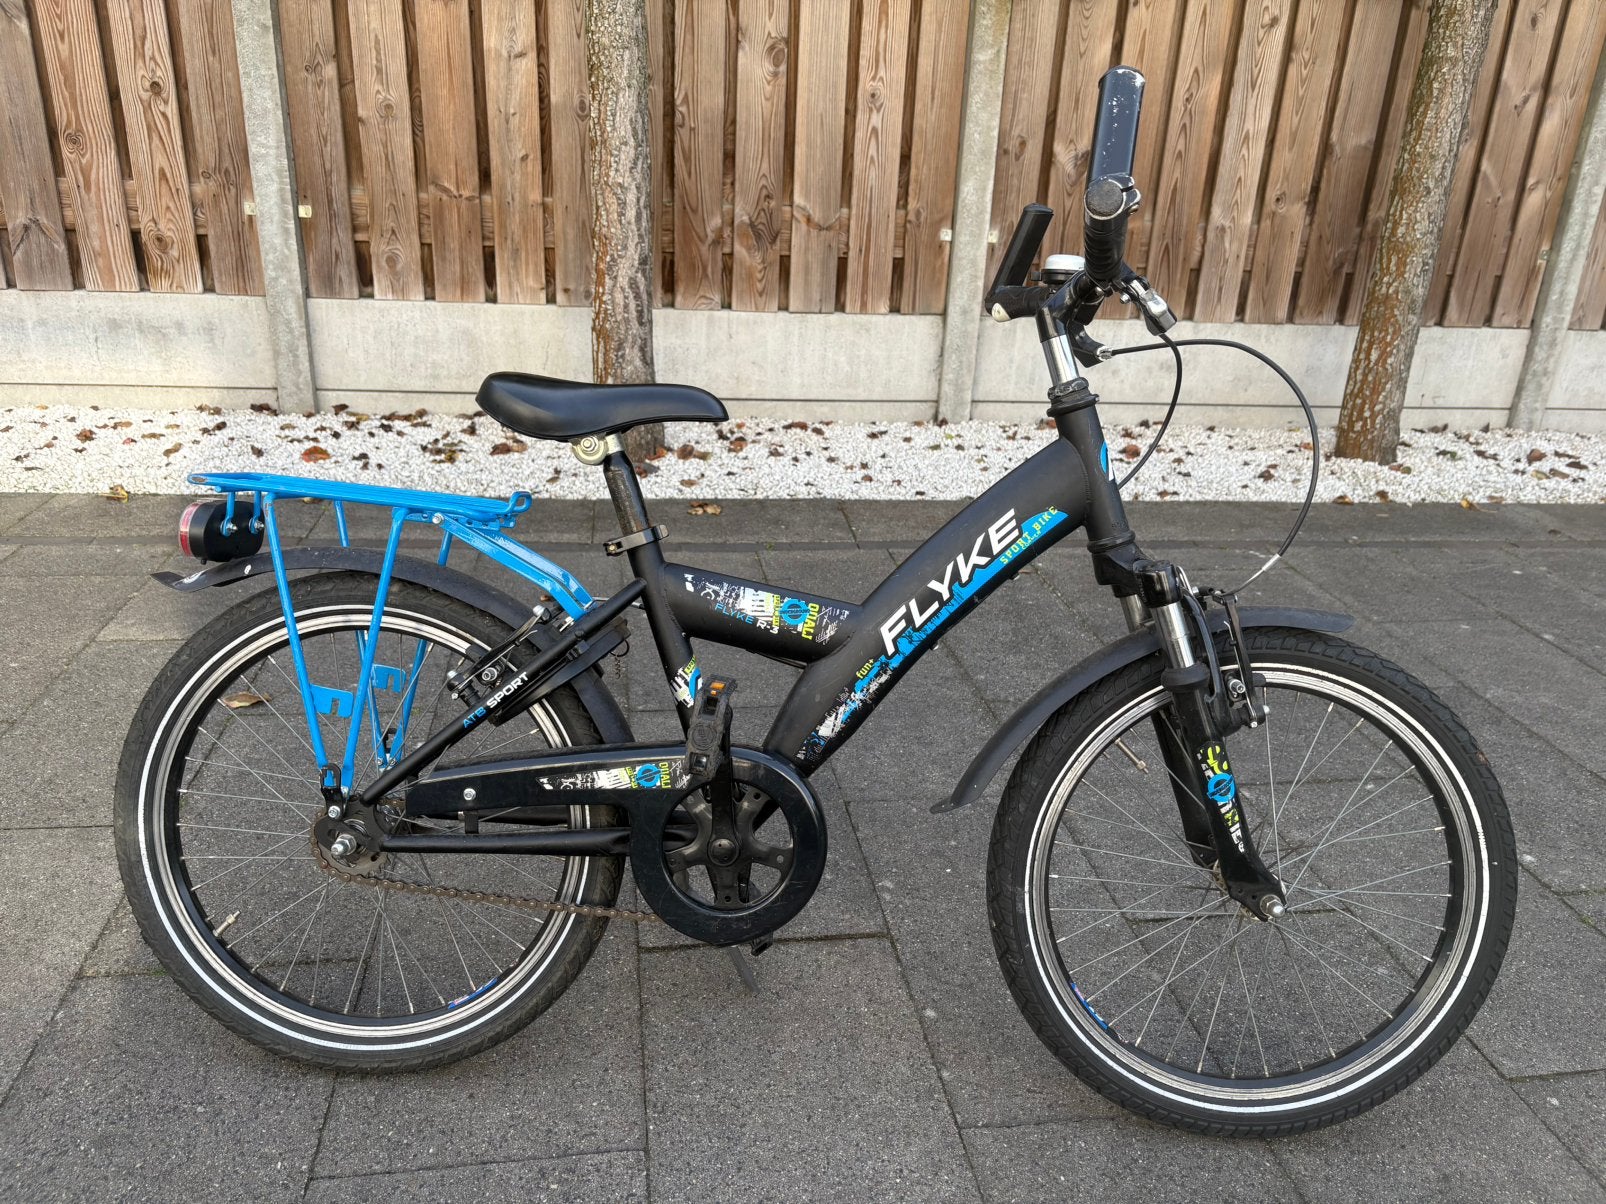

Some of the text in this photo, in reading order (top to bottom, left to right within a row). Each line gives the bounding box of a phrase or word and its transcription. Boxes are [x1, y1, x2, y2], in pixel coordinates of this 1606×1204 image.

[1000, 505, 1058, 565] SPORT BIKE
[880, 508, 1021, 656] FLYKE
[714, 602, 755, 625] FLYKE
[756, 618, 780, 635] R-3
[856, 658, 875, 680] fun+
[463, 671, 528, 728] ATB SPORT
